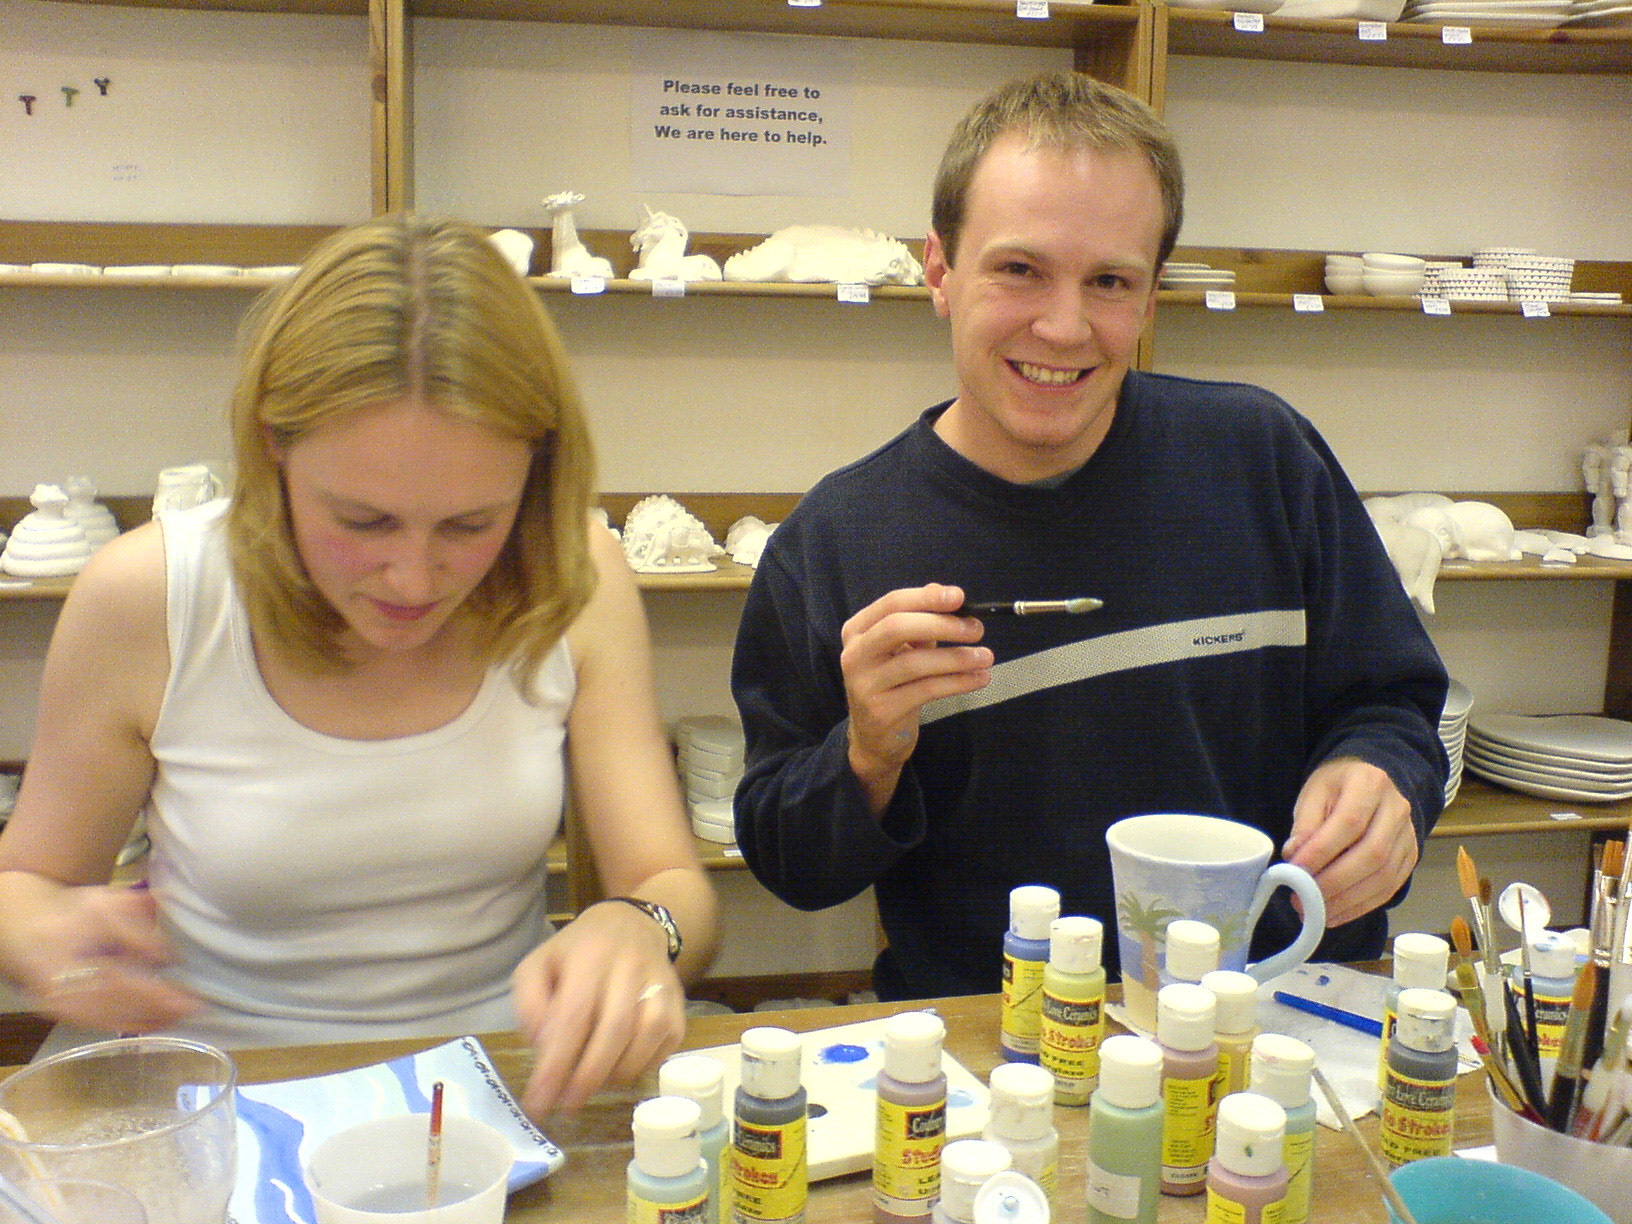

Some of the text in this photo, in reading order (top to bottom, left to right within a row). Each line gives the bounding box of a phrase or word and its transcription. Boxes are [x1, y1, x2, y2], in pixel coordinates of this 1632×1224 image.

[663, 80, 820, 99] Please feel free to
[660, 103, 823, 124] ask for assistance,
[654, 125, 827, 147] We are here to help.
[1192, 632, 1244, 645] KICKERS
